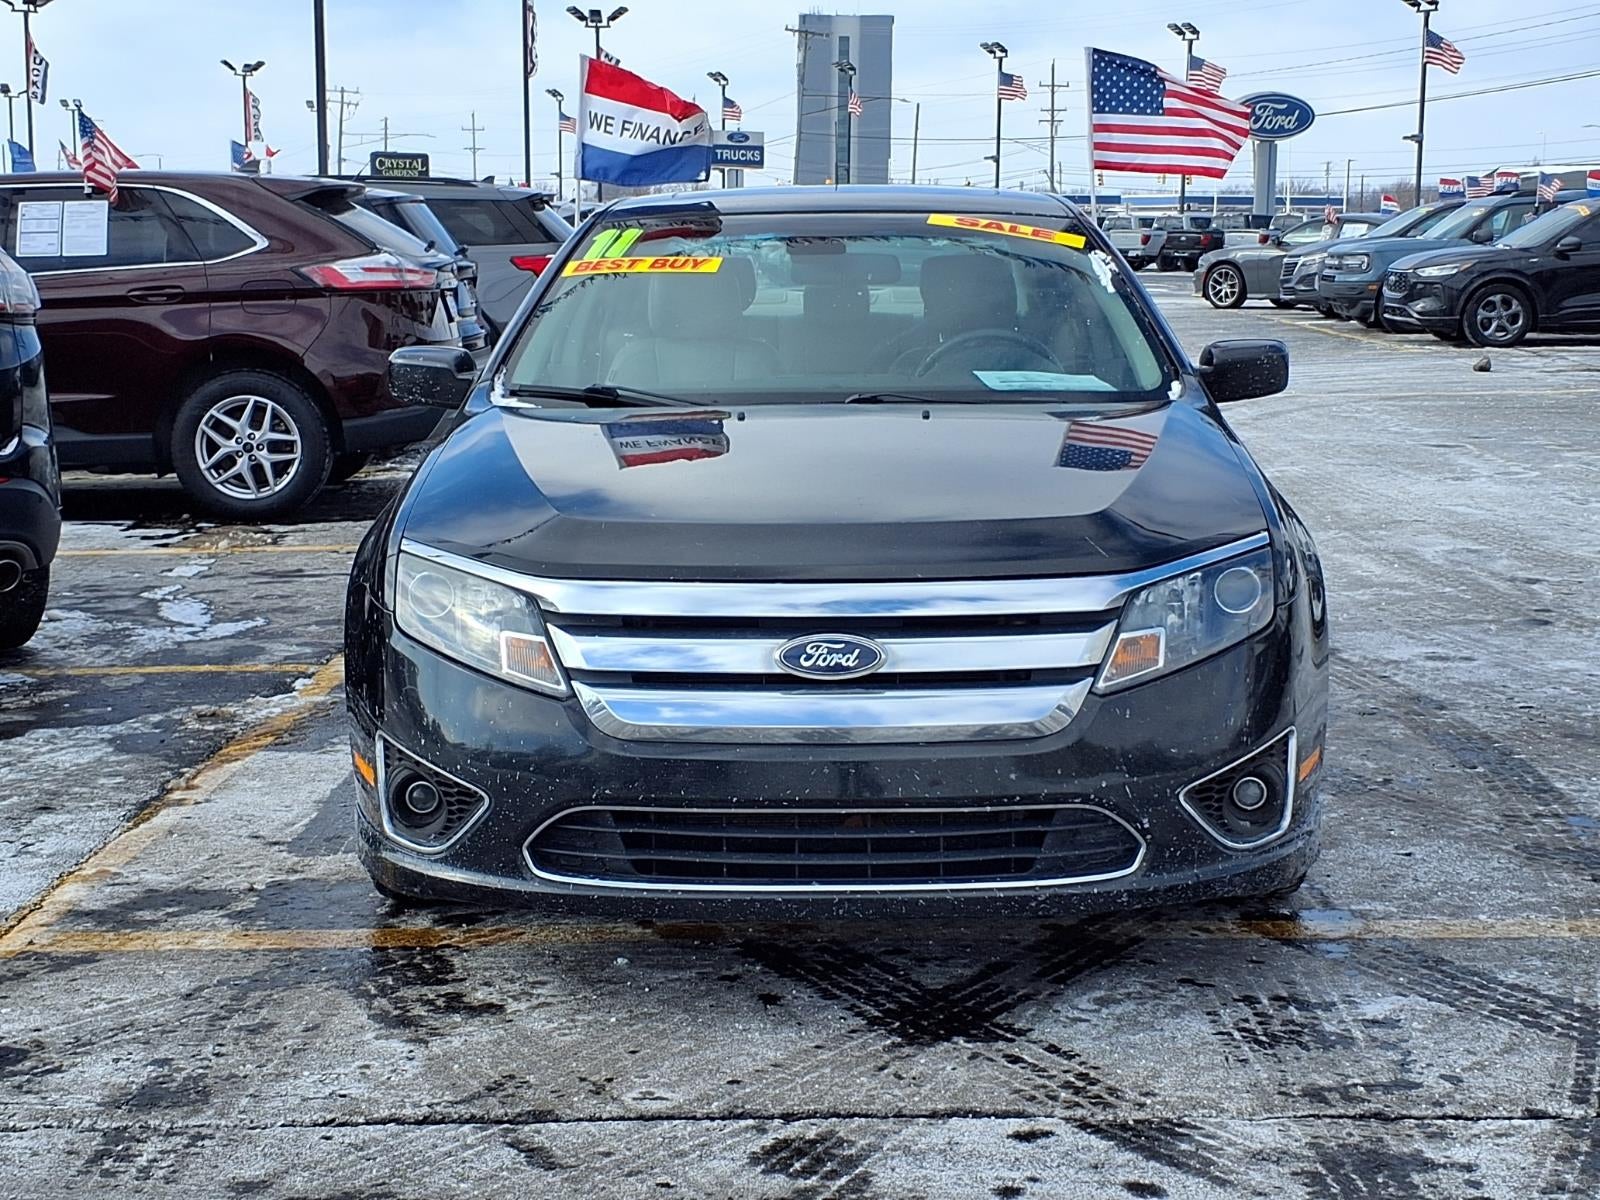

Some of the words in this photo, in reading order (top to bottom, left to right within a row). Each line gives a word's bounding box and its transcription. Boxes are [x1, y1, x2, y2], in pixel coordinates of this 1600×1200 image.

[588, 110, 616, 136] WE
[1249, 102, 1300, 130] Ford
[375, 156, 427, 171] CRYSTAL
[715, 149, 761, 162] TRUCKS
[382, 169, 419, 177] GARDENS
[954, 217, 1057, 241] SALE
[584, 228, 645, 261] 11
[572, 257, 645, 274] BEST
[648, 257, 712, 272] BUY
[799, 642, 861, 668] Ford
